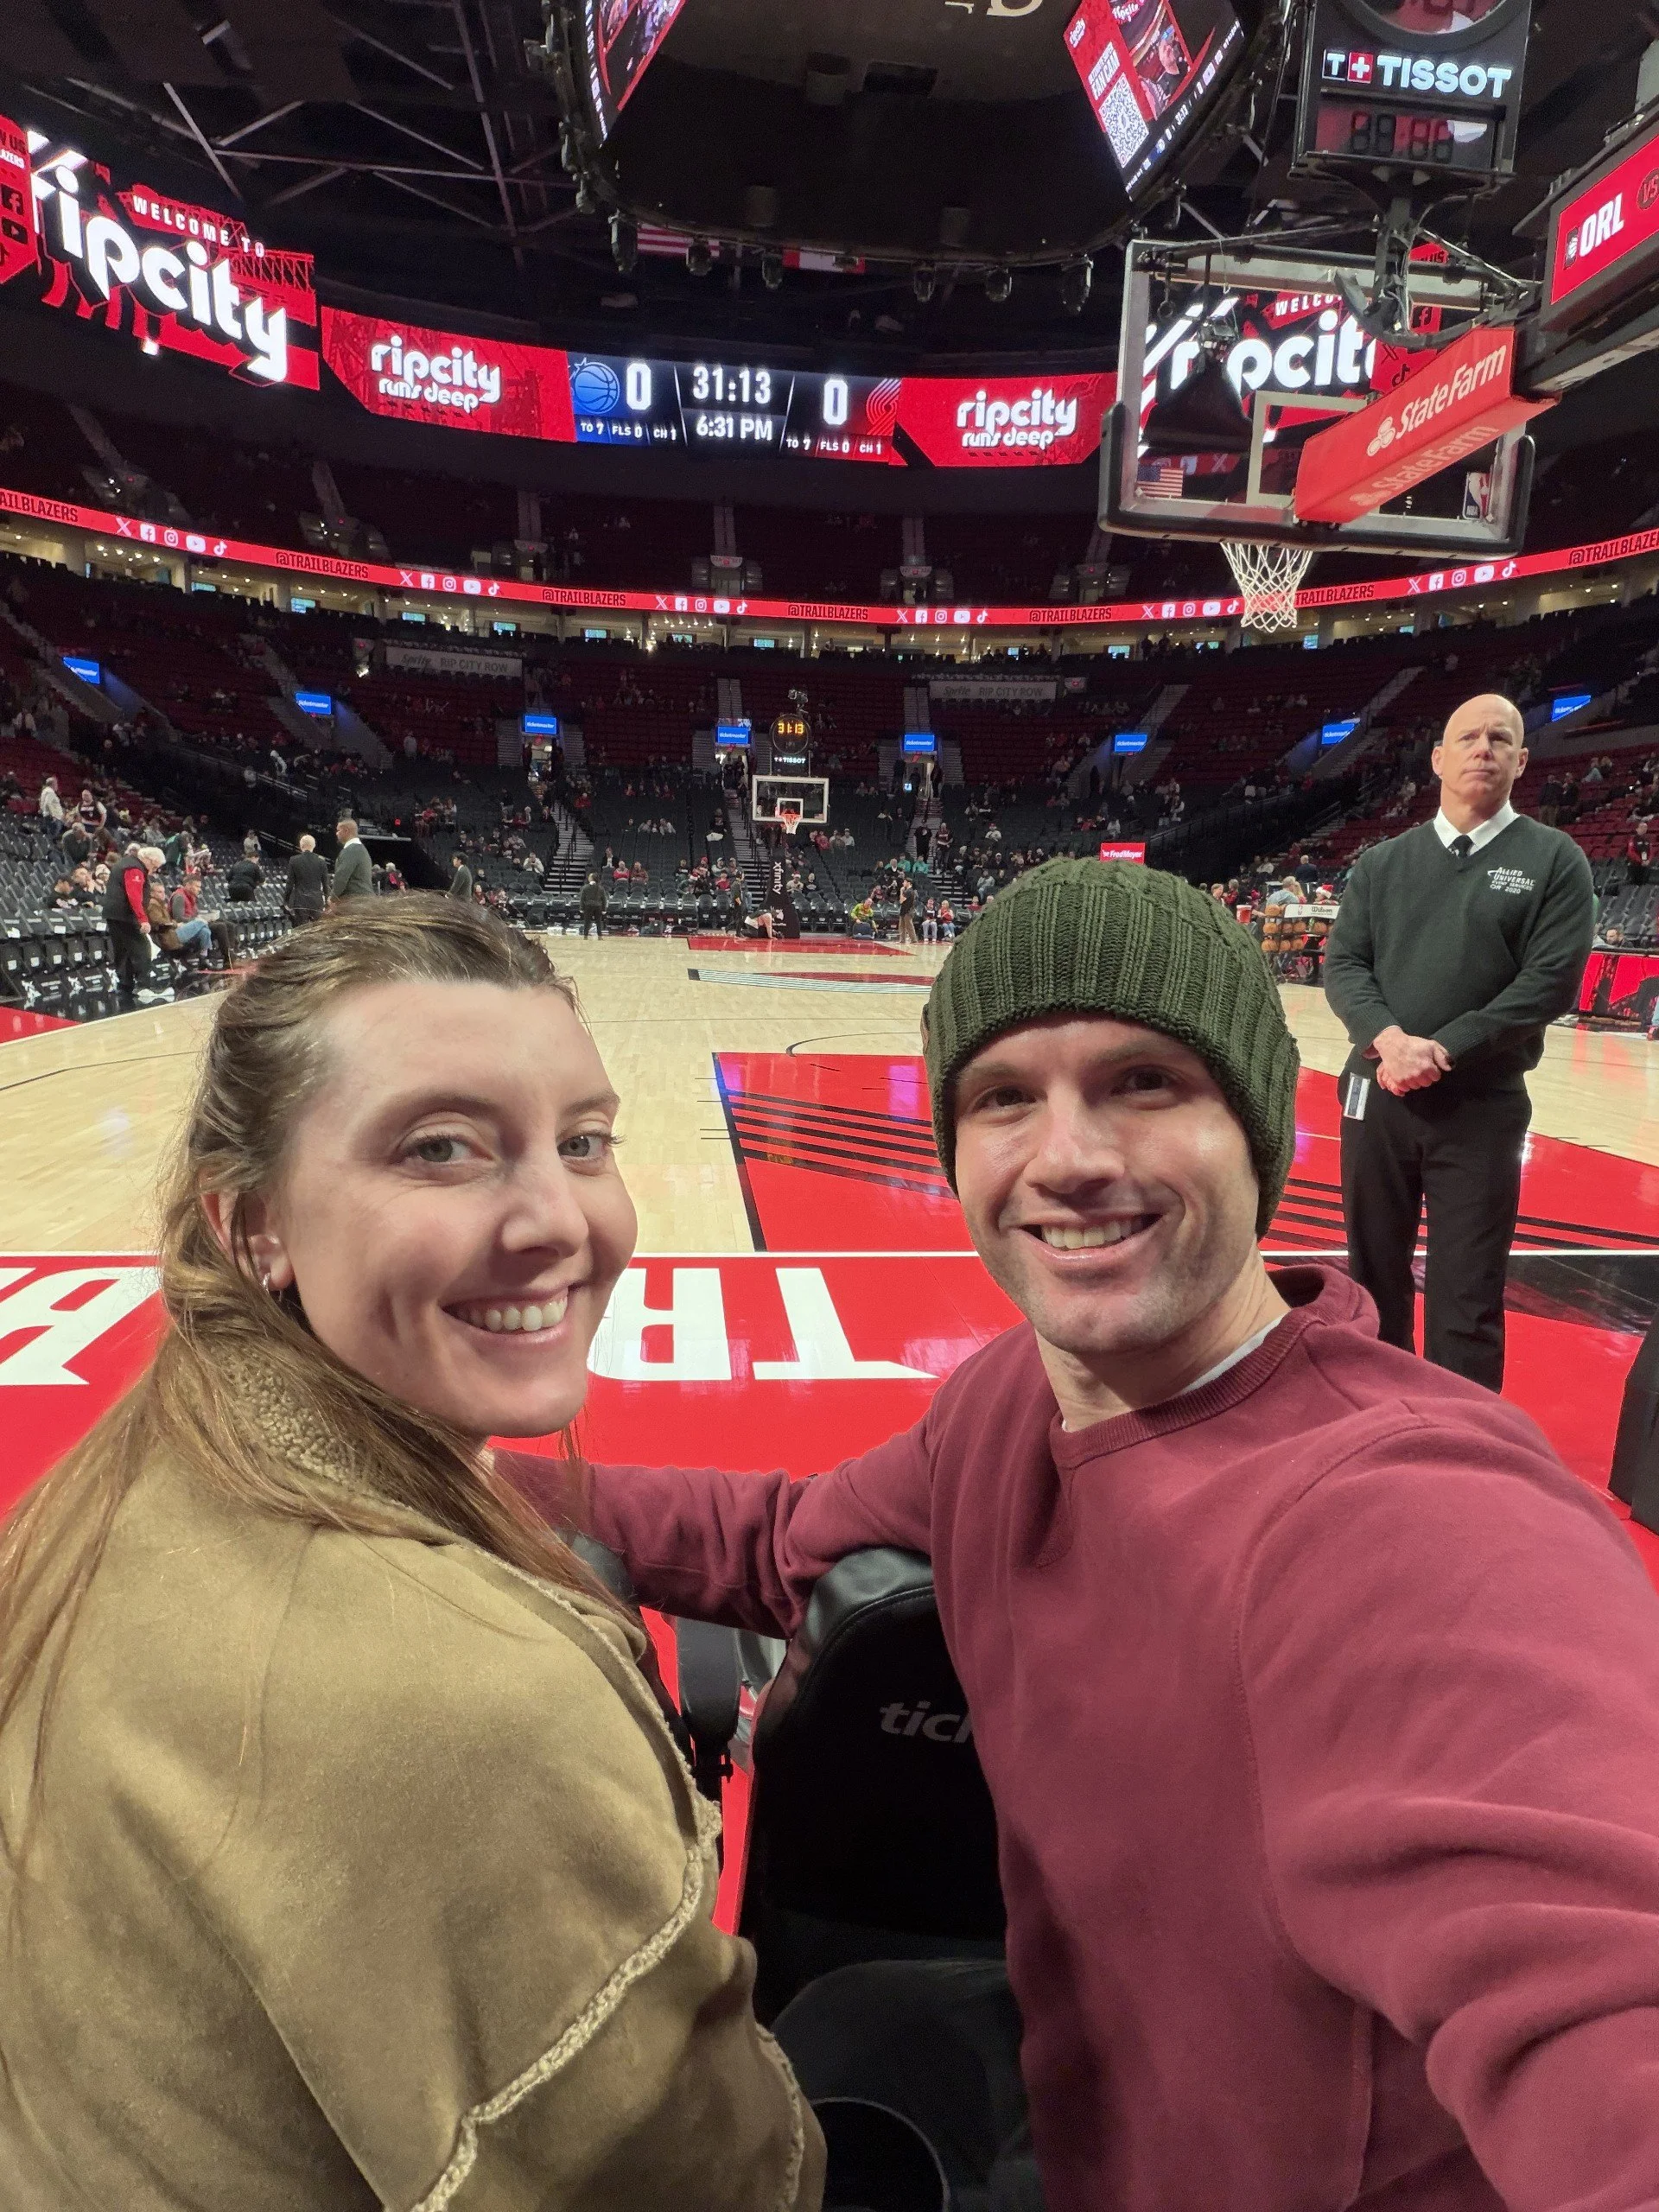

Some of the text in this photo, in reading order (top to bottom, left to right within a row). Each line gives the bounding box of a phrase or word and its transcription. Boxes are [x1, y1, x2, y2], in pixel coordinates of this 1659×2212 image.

[1376, 54, 1512, 99] TISSOT
[133, 194, 265, 258] WELCOME TO
[1580, 193, 1624, 257] ORL
[372, 335, 501, 403] ripcity
[378, 378, 479, 413] runs deep
[626, 363, 652, 410] 0
[693, 366, 771, 404] 31:13
[823, 379, 848, 425] 0
[957, 389, 1077, 435] ripcity
[581, 423, 677, 440] TO 7 FLS 0 CH 1
[696, 416, 772, 441] 6:31 PM
[962, 427, 1054, 450] runs deep
[786, 438, 881, 454] TO 7 FLS 0 CH 1
[275, 552, 369, 579] @TRAILBLAZERS
[542, 588, 626, 607] @TRAILBLAZERS
[787, 604, 868, 620] @TRAILBLAZERS
[1028, 607, 1112, 623] @TRAILBLAZERS
[778, 722, 804, 734] 31:13
[772, 861, 785, 895] xfinity
[1493, 873, 1535, 886] UNIVERSAL
[1497, 867, 1523, 877] ALLIED
